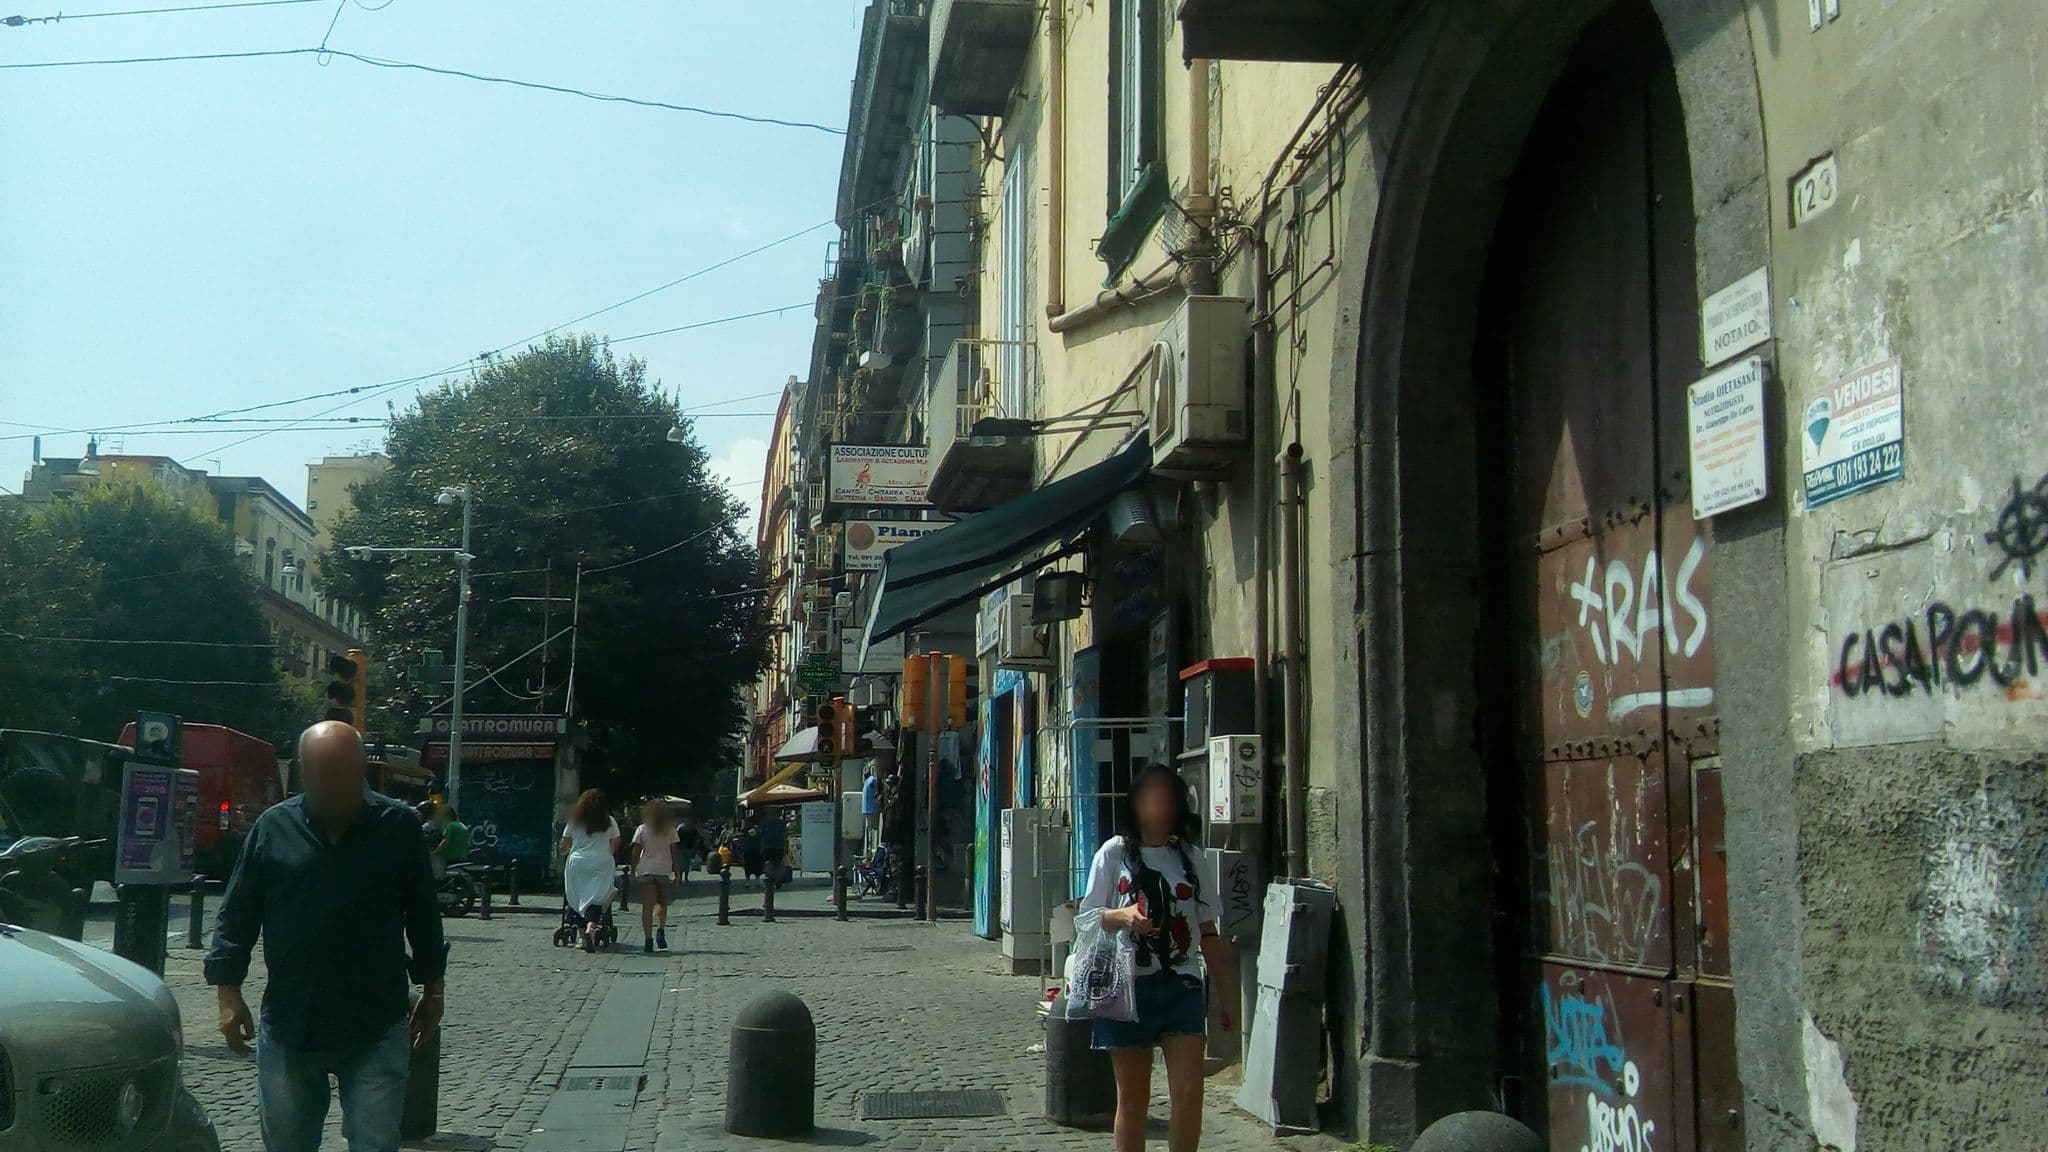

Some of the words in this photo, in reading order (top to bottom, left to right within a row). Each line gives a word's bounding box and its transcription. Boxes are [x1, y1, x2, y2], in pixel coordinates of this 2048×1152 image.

[1714, 319, 1753, 353] NOTAIO
[1834, 364, 1898, 411] VENDESI
[834, 447, 896, 458] ASSOCIAZIONE
[1836, 461, 1852, 487] 081
[1854, 454, 1869, 481] 193
[1869, 448, 1881, 476] 24
[1882, 443, 1901, 472] 222
[437, 720, 554, 732] QATTROMURA
